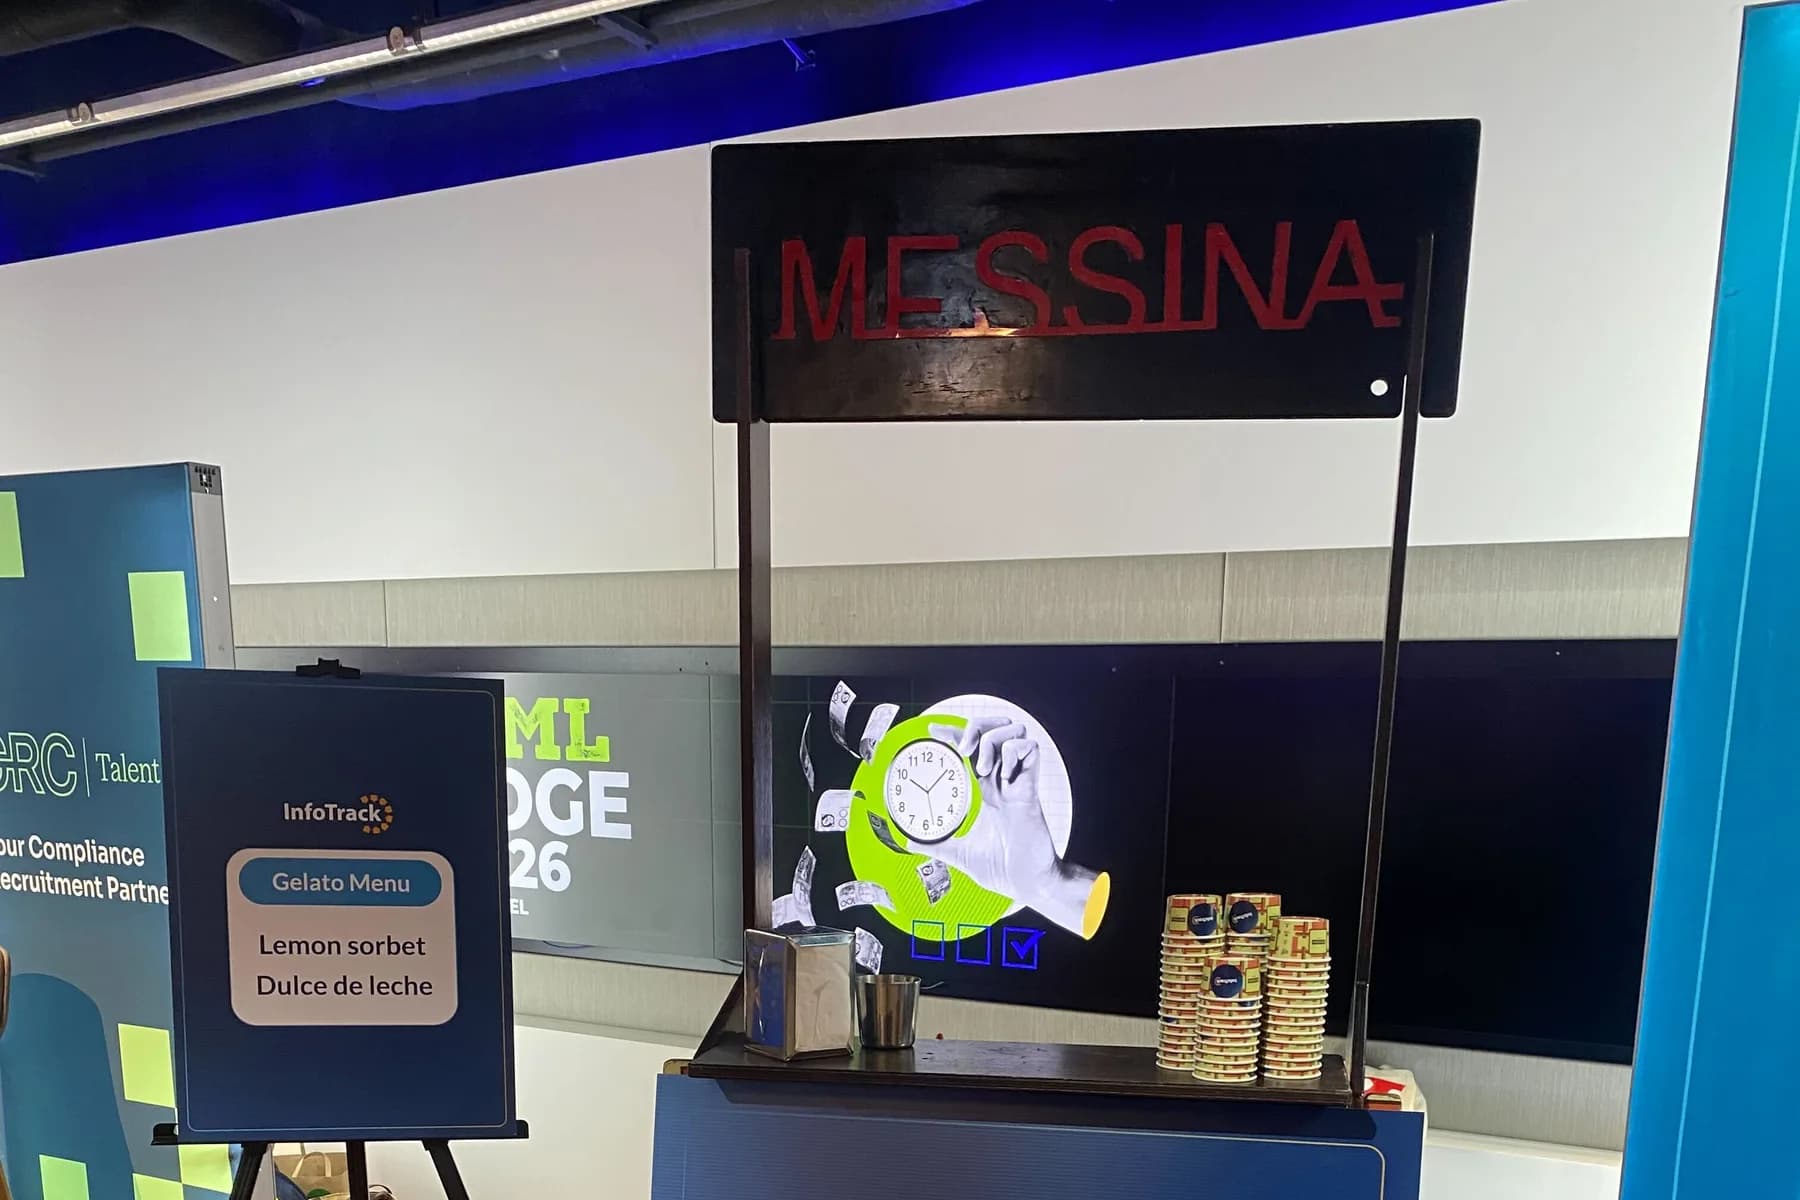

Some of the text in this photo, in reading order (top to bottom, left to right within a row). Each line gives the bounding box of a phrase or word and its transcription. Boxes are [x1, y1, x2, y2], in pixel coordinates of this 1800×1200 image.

[772, 219, 1404, 342] MESSINA
[909, 755, 918, 767] 11
[922, 751, 933, 763] 12
[95, 753, 161, 784] Talent
[898, 769, 908, 780] 10
[948, 769, 955, 780] 2
[895, 784, 902, 796] 9
[952, 786, 959, 798] 3
[283, 803, 382, 822] InfoTrack
[899, 801, 906, 813] 8
[947, 804, 954, 815] 4
[909, 814, 915, 825] 7
[922, 819, 930, 831] 6
[936, 816, 943, 827] 5
[29, 835, 145, 867] Compliance
[0, 870, 103, 899] ecruitment
[272, 873, 410, 892] Gelato Menu
[259, 934, 426, 955] Lemon sorbet
[257, 975, 433, 996] Dulce de leche
